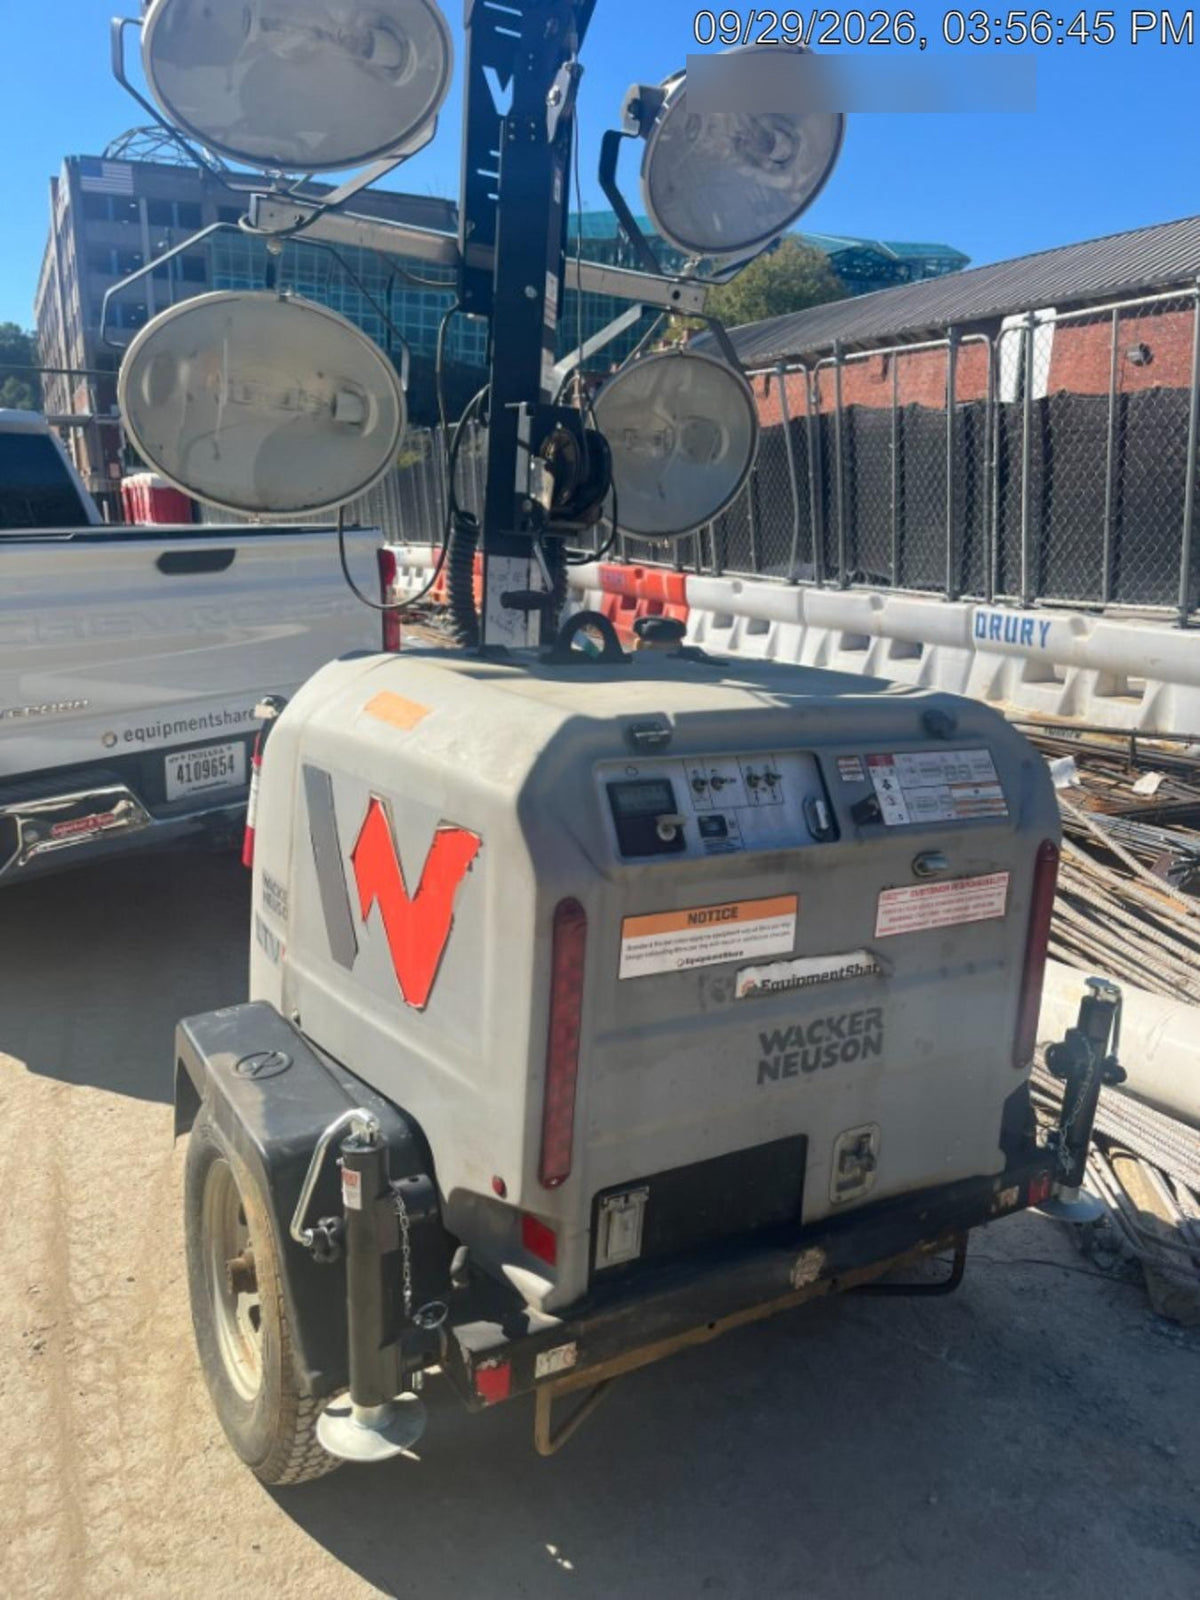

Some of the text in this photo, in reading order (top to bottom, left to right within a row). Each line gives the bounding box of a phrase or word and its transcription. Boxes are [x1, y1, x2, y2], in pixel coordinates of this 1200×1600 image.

[974, 610, 1052, 648] DRURY
[176, 754, 235, 785] 4109654
[687, 906, 740, 925] NOTICE
[760, 962, 881, 993] EquipmentShar
[758, 1007, 884, 1057] WACKER
[756, 1032, 884, 1085] NEUSON
